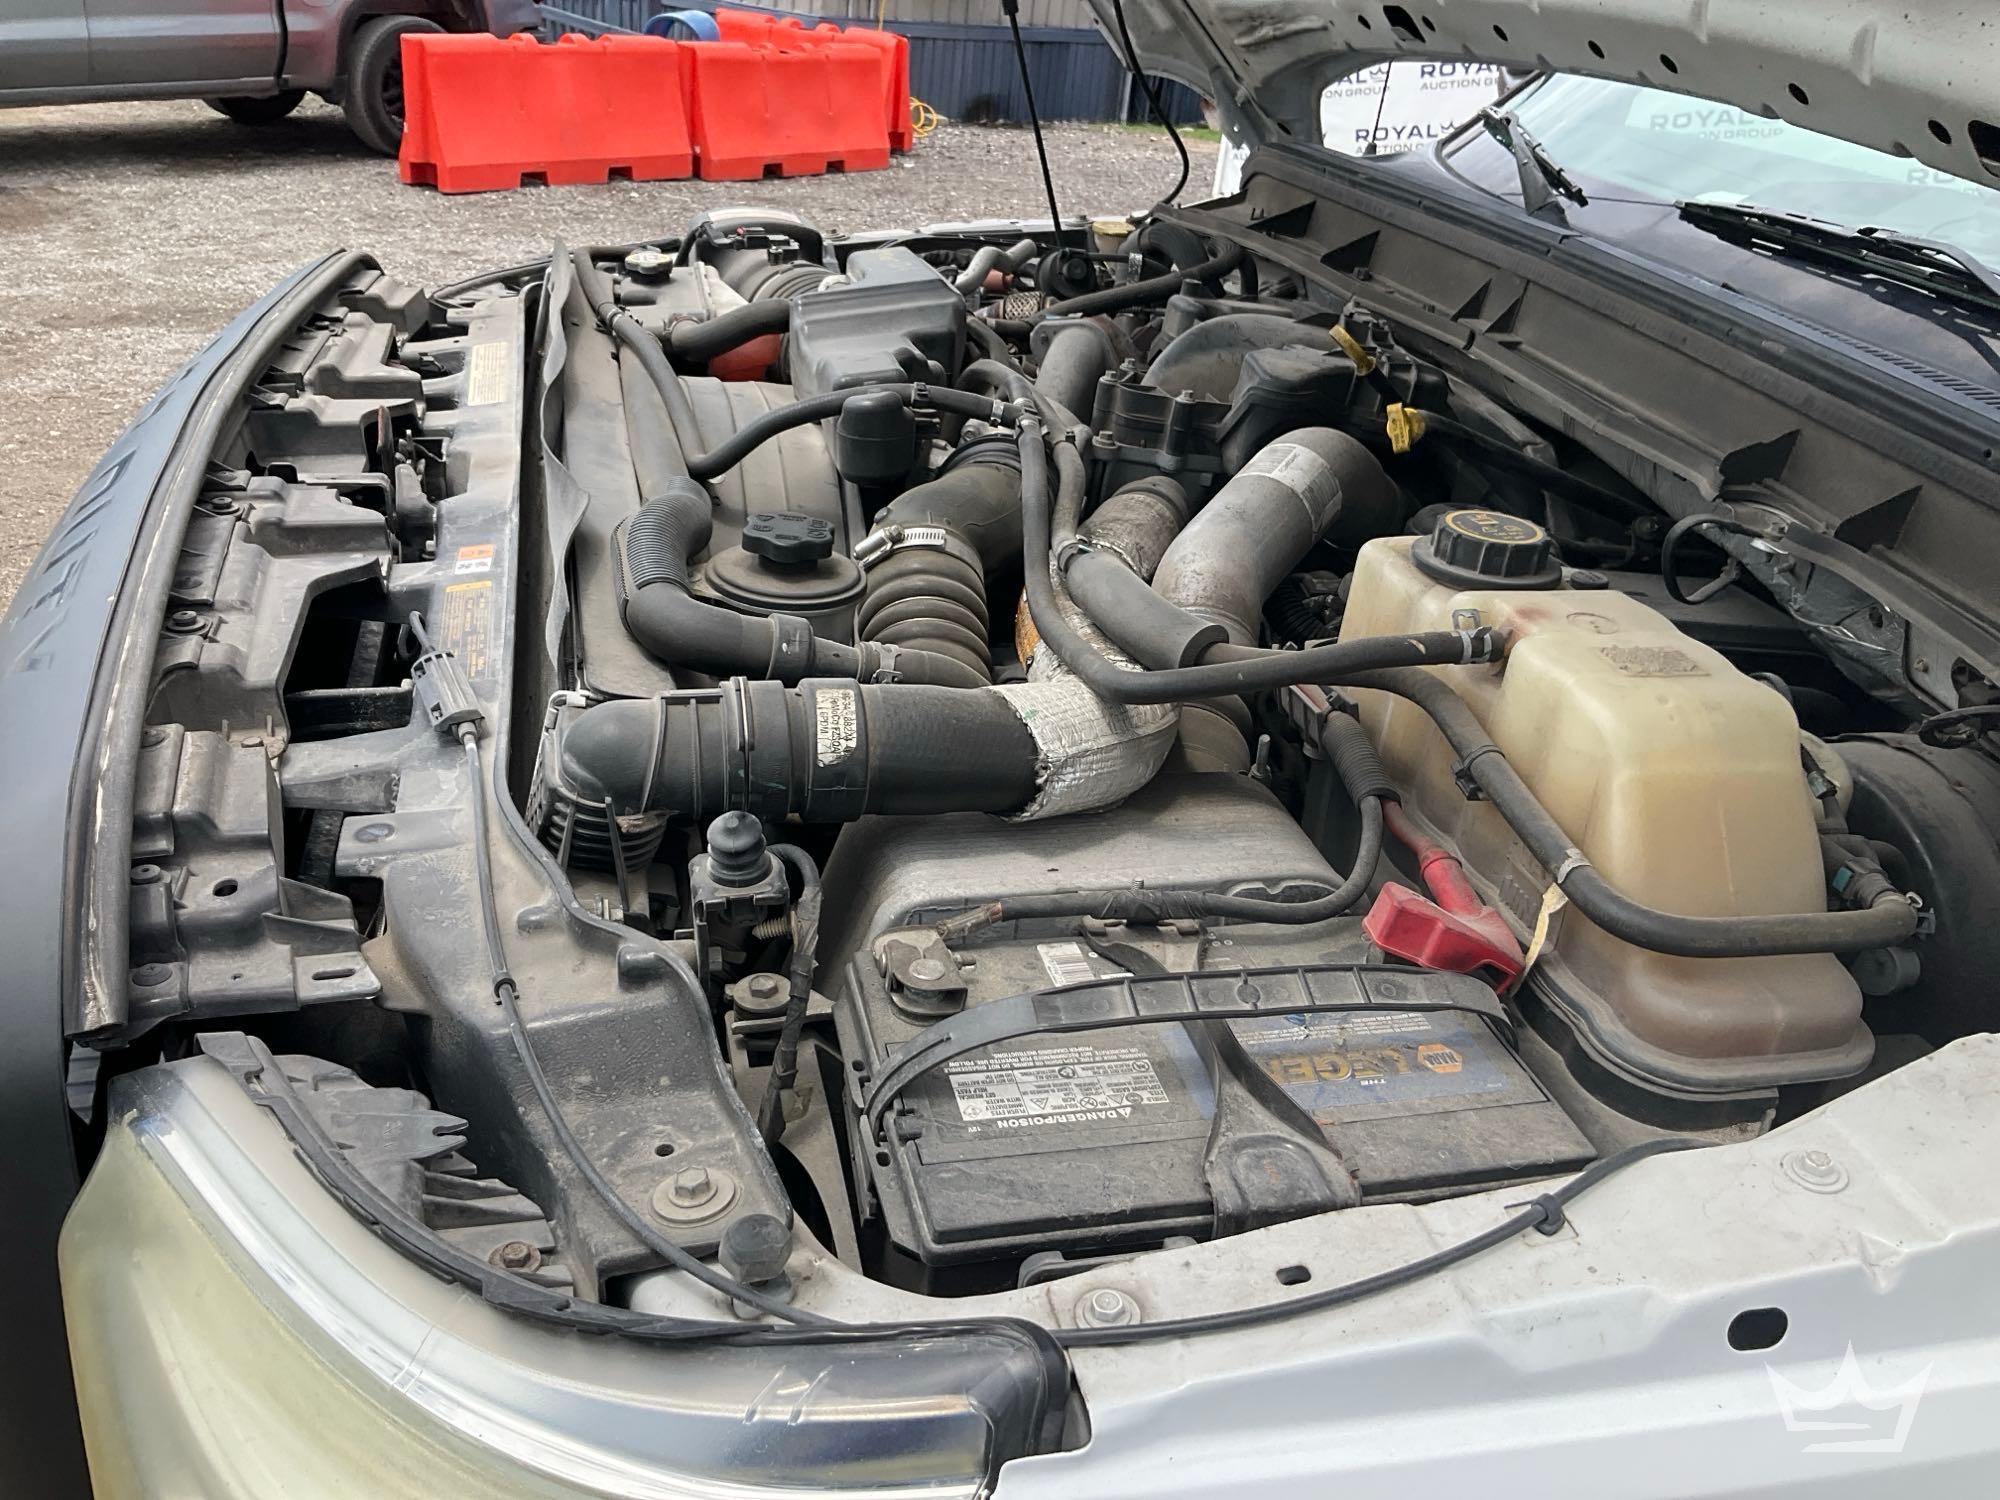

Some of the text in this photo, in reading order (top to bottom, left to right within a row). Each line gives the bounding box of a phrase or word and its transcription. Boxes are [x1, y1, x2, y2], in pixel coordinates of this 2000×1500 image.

[1345, 85, 1389, 97] GROU
[1420, 79, 1480, 90] AUCTION
[1649, 109, 1755, 130] ROYAL
[1355, 124, 1438, 142] ROYAL
[1360, 1077, 1388, 1087] THE
[995, 1109, 1118, 1129] DANGER/POISON
